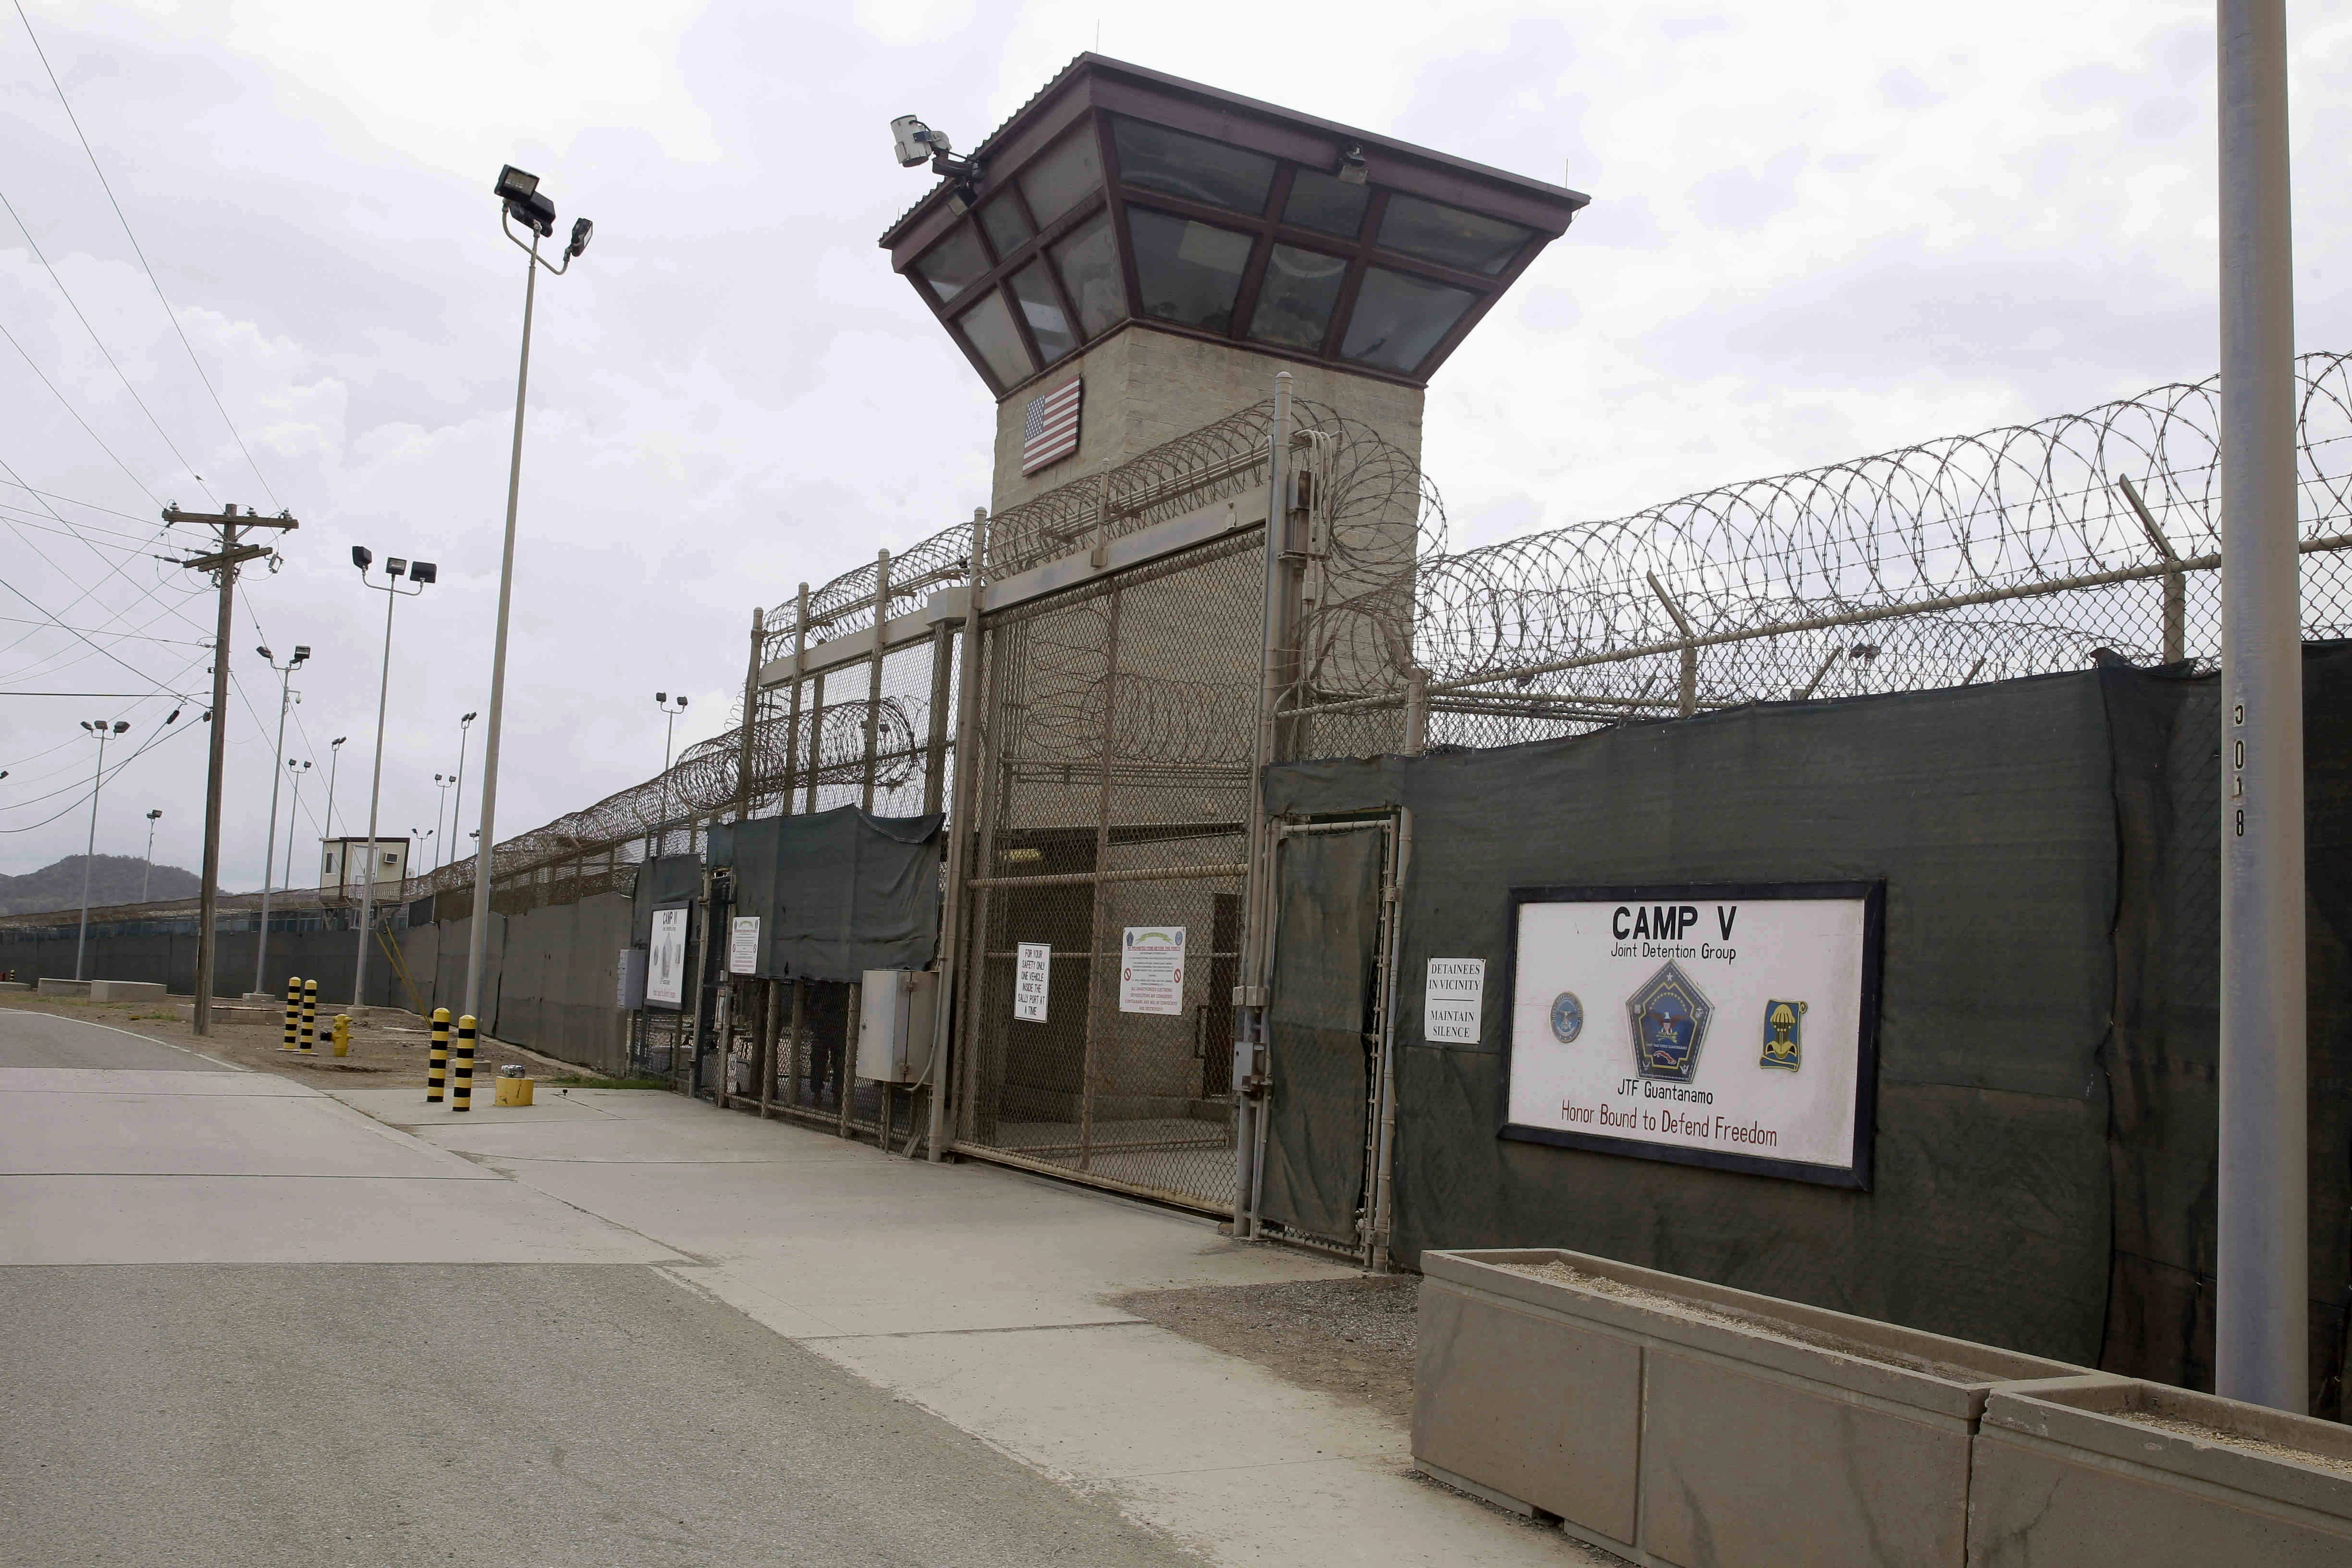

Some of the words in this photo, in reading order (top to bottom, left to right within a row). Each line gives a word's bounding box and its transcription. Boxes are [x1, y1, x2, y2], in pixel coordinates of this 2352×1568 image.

[1613, 906, 1698, 940] CAMP
[1717, 906, 1737, 941] V
[1033, 949, 1042, 958] YOUR
[1611, 942, 1637, 957] Joint
[1642, 942, 1696, 959] Detention
[1701, 943, 1736, 965] Group
[1022, 960, 1036, 969] SAFETY
[1037, 961, 1045, 970] ONLY
[1431, 964, 1480, 975] DETAINEES
[1029, 972, 1044, 982] VEHICLE
[1022, 982, 1033, 992] INSIDE
[1429, 979, 1438, 989] IN
[1440, 980, 1481, 991] VICINITY
[1018, 993, 1029, 1003] SALLY
[1029, 994, 1039, 1004] PORT
[1040, 996, 1045, 1005] AT
[1024, 1005, 1027, 1015] A
[1029, 1005, 1037, 1016] TIME
[1430, 1010, 1474, 1022] MAINTAIN
[1433, 1026, 1470, 1038] SILENCE
[1617, 1078, 1641, 1096] JTF
[1644, 1081, 1713, 1105] Guantanamo
[1562, 1099, 1595, 1124] Honor
[1600, 1103, 1637, 1129] Bound
[1642, 1109, 1656, 1131] to
[1661, 1110, 1709, 1138] Defend
[1715, 1116, 1777, 1147] Freedom
